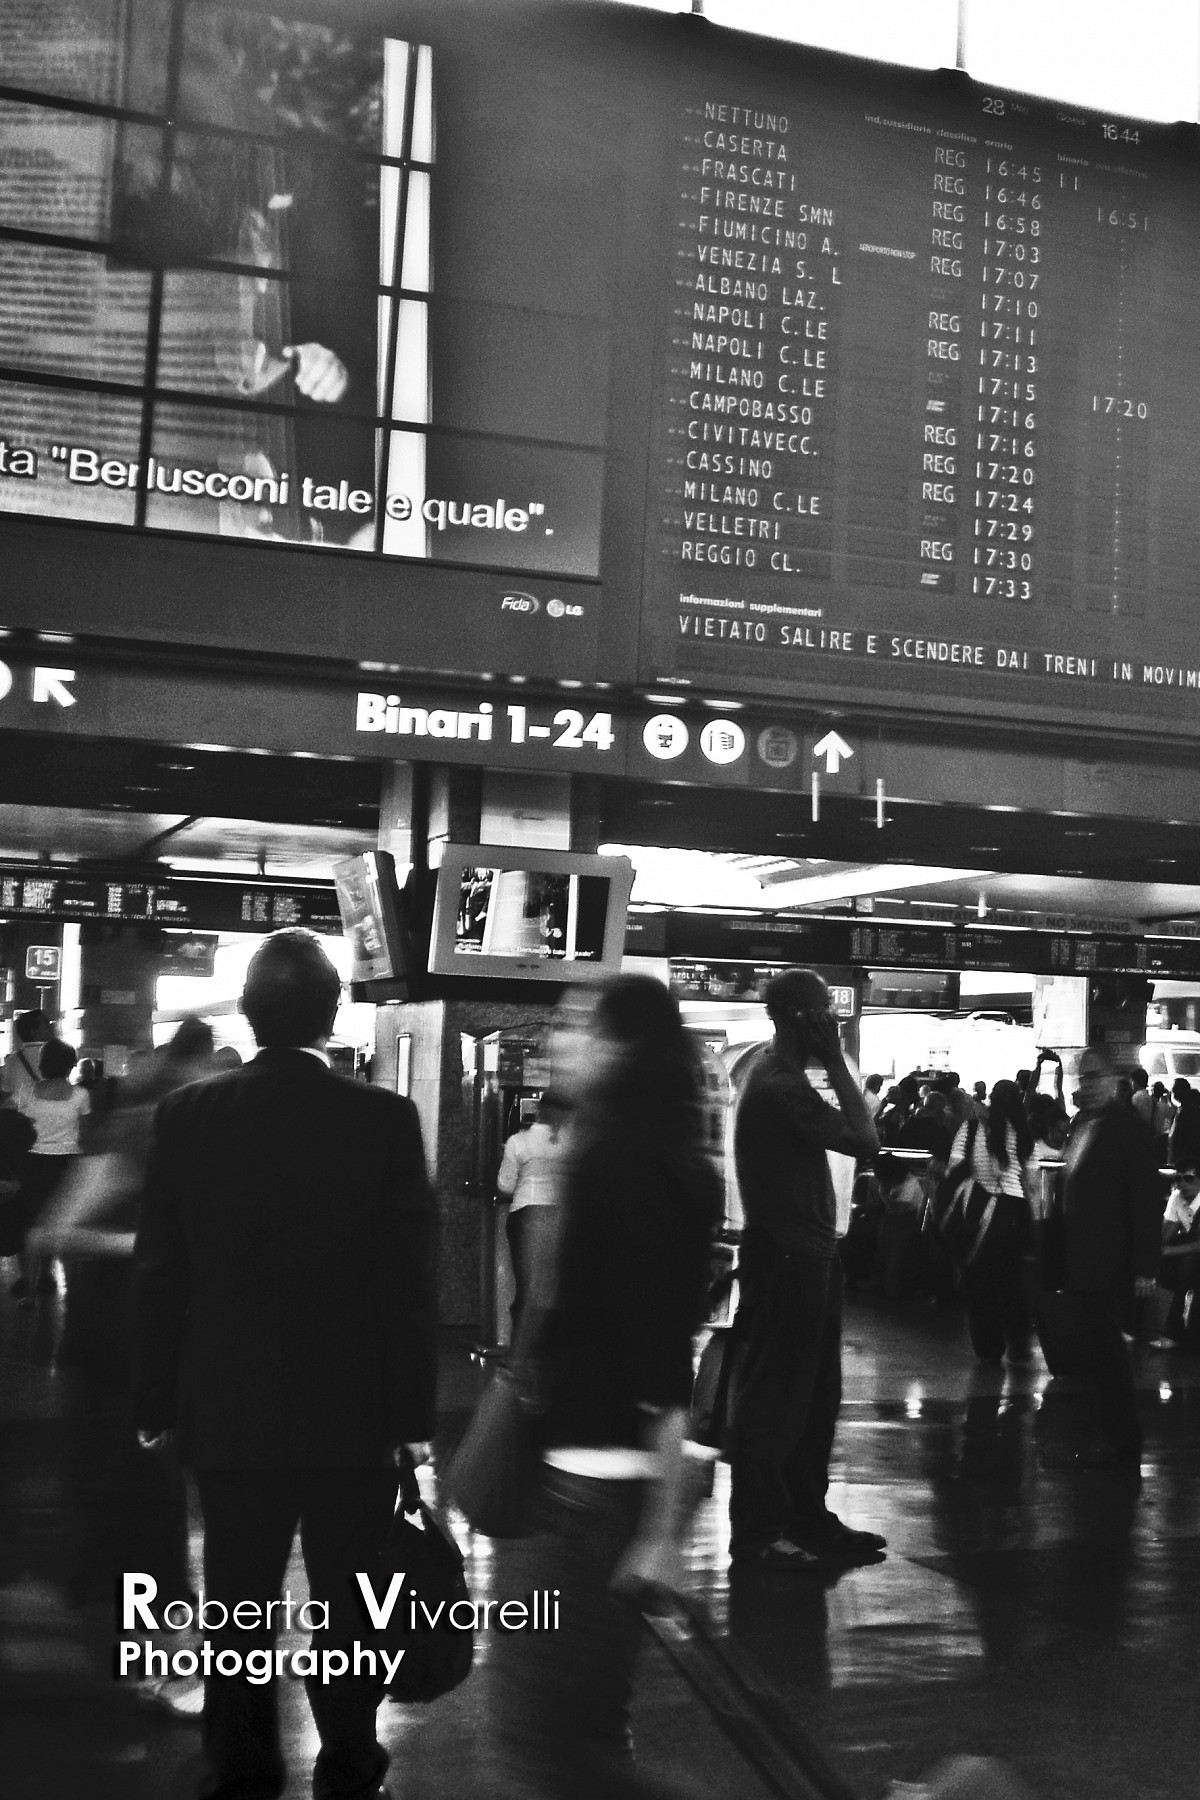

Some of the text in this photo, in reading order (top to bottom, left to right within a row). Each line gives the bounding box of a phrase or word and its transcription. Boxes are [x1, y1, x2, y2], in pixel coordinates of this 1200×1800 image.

[982, 97, 1005, 116] 28
[704, 131, 1041, 210] CASERTA REG 16:46
[705, 101, 1078, 190] NETTUNO REG 16:45 11
[701, 187, 1040, 263] FIRENZE SMN REG 17:03
[702, 158, 795, 191] FRASCATI
[933, 201, 964, 222] REG
[985, 211, 1040, 236] 16:58
[1098, 207, 1148, 231] 16:51
[698, 245, 1038, 318] VENEZIA S. L 17:10
[699, 215, 807, 250] FIUMICINO
[822, 237, 839, 255] A.
[930, 256, 962, 277] REG
[983, 266, 1039, 290] 17:07
[694, 303, 1036, 373] NAPOLI C.LE REG 17:13
[695, 273, 1035, 346] ALBANO LAZ. REG 17:11
[690, 362, 1147, 429] MILANO C.LE 17:16 17:20
[692, 332, 1035, 401] NAPOLI C.LE 17:15
[688, 421, 1033, 485] CIVITAVECC. REG 17:20
[690, 391, 1034, 457] CAMPOBASSO REG 17:16
[51, 445, 289, 505] "Berlusconi
[303, 480, 372, 514] tale
[385, 493, 412, 520] e
[423, 493, 554, 537] quale".
[684, 481, 758, 507] MILANO
[773, 492, 820, 515] C.LE
[974, 519, 1033, 541] 17:29
[686, 450, 1033, 514] CASSINO REG 17:24
[682, 541, 1031, 600] REGGIO CL. 17:33
[684, 511, 1031, 571] VELLETRI REG 17:30
[501, 596, 584, 616] Fida LG
[679, 594, 821, 617] informazioni supplementari
[679, 615, 765, 641] VIETATO
[780, 626, 852, 650] SALIRE
[867, 635, 876, 653] E
[891, 637, 984, 665] SCENDERE
[997, 649, 1027, 669] DAI
[1044, 654, 1096, 677] TRENI
[1113, 662, 1132, 680] IN
[356, 692, 615, 750] Binari 1-24
[34, 949, 56, 966] 15
[832, 988, 850, 1005] 18
